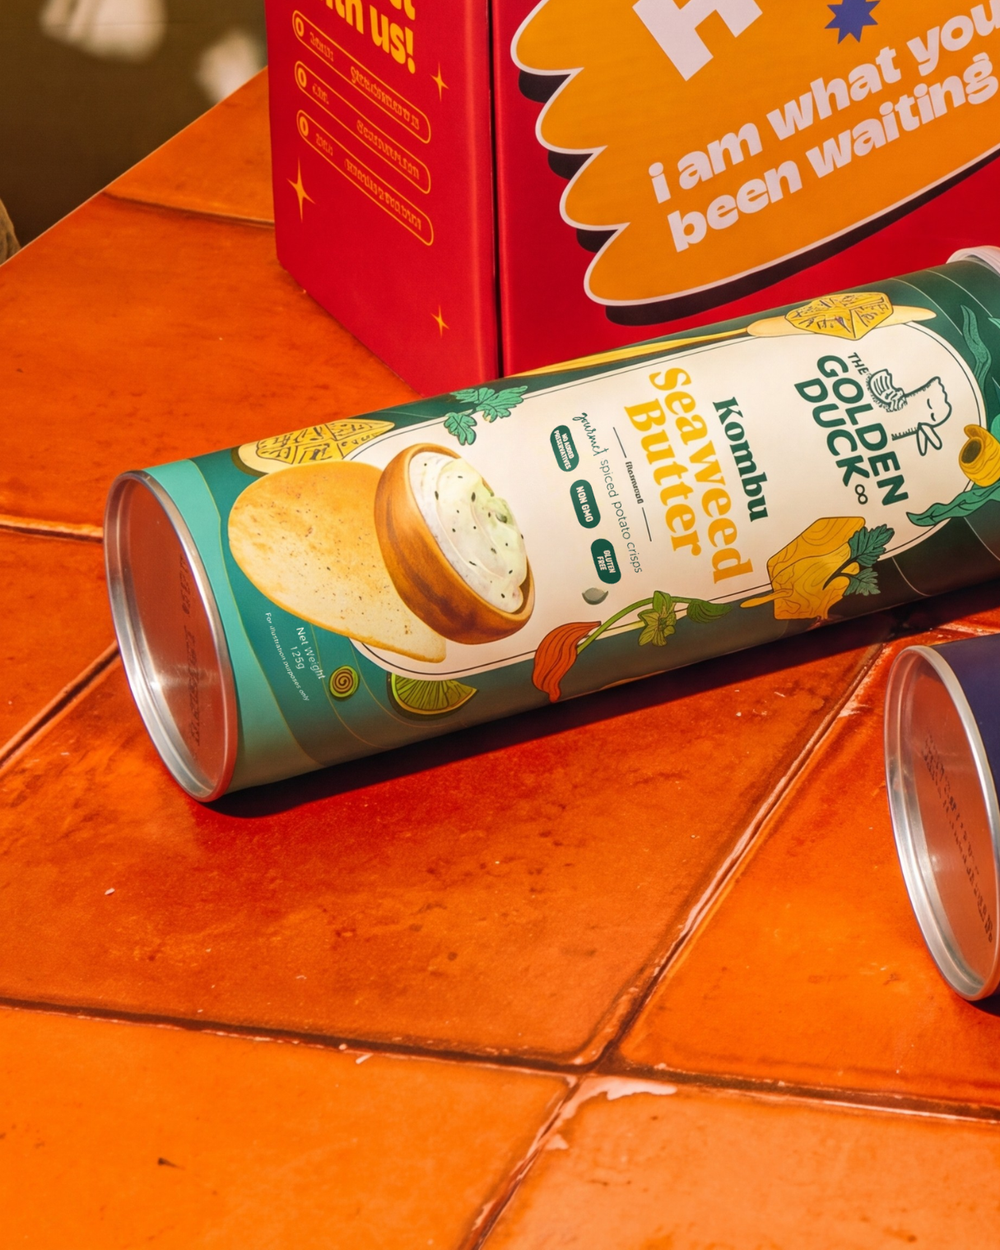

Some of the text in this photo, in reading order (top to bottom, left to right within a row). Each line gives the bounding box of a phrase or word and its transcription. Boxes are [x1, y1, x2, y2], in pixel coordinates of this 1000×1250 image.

[370, 0, 416, 74] us!
[648, 163, 668, 204] i
[676, 118, 761, 192] am
[766, 43, 900, 131] what
[666, 157, 803, 254] been
[796, 51, 1000, 178] waiting
[847, 351, 869, 376] THE
[572, 412, 643, 574] gourmet spiced potato crisps
[623, 398, 702, 557] Butter
[648, 366, 755, 585] Seaweed
[712, 396, 769, 523] Kombu
[793, 378, 870, 505] DUCK CO
[816, 355, 909, 507] GOLDEN
[575, 485, 594, 523] NON GMO
[596, 555, 608, 571] FREE
[290, 646, 306, 670] 125g
[295, 627, 326, 680] Net Weight
[299, 689, 310, 701] only
